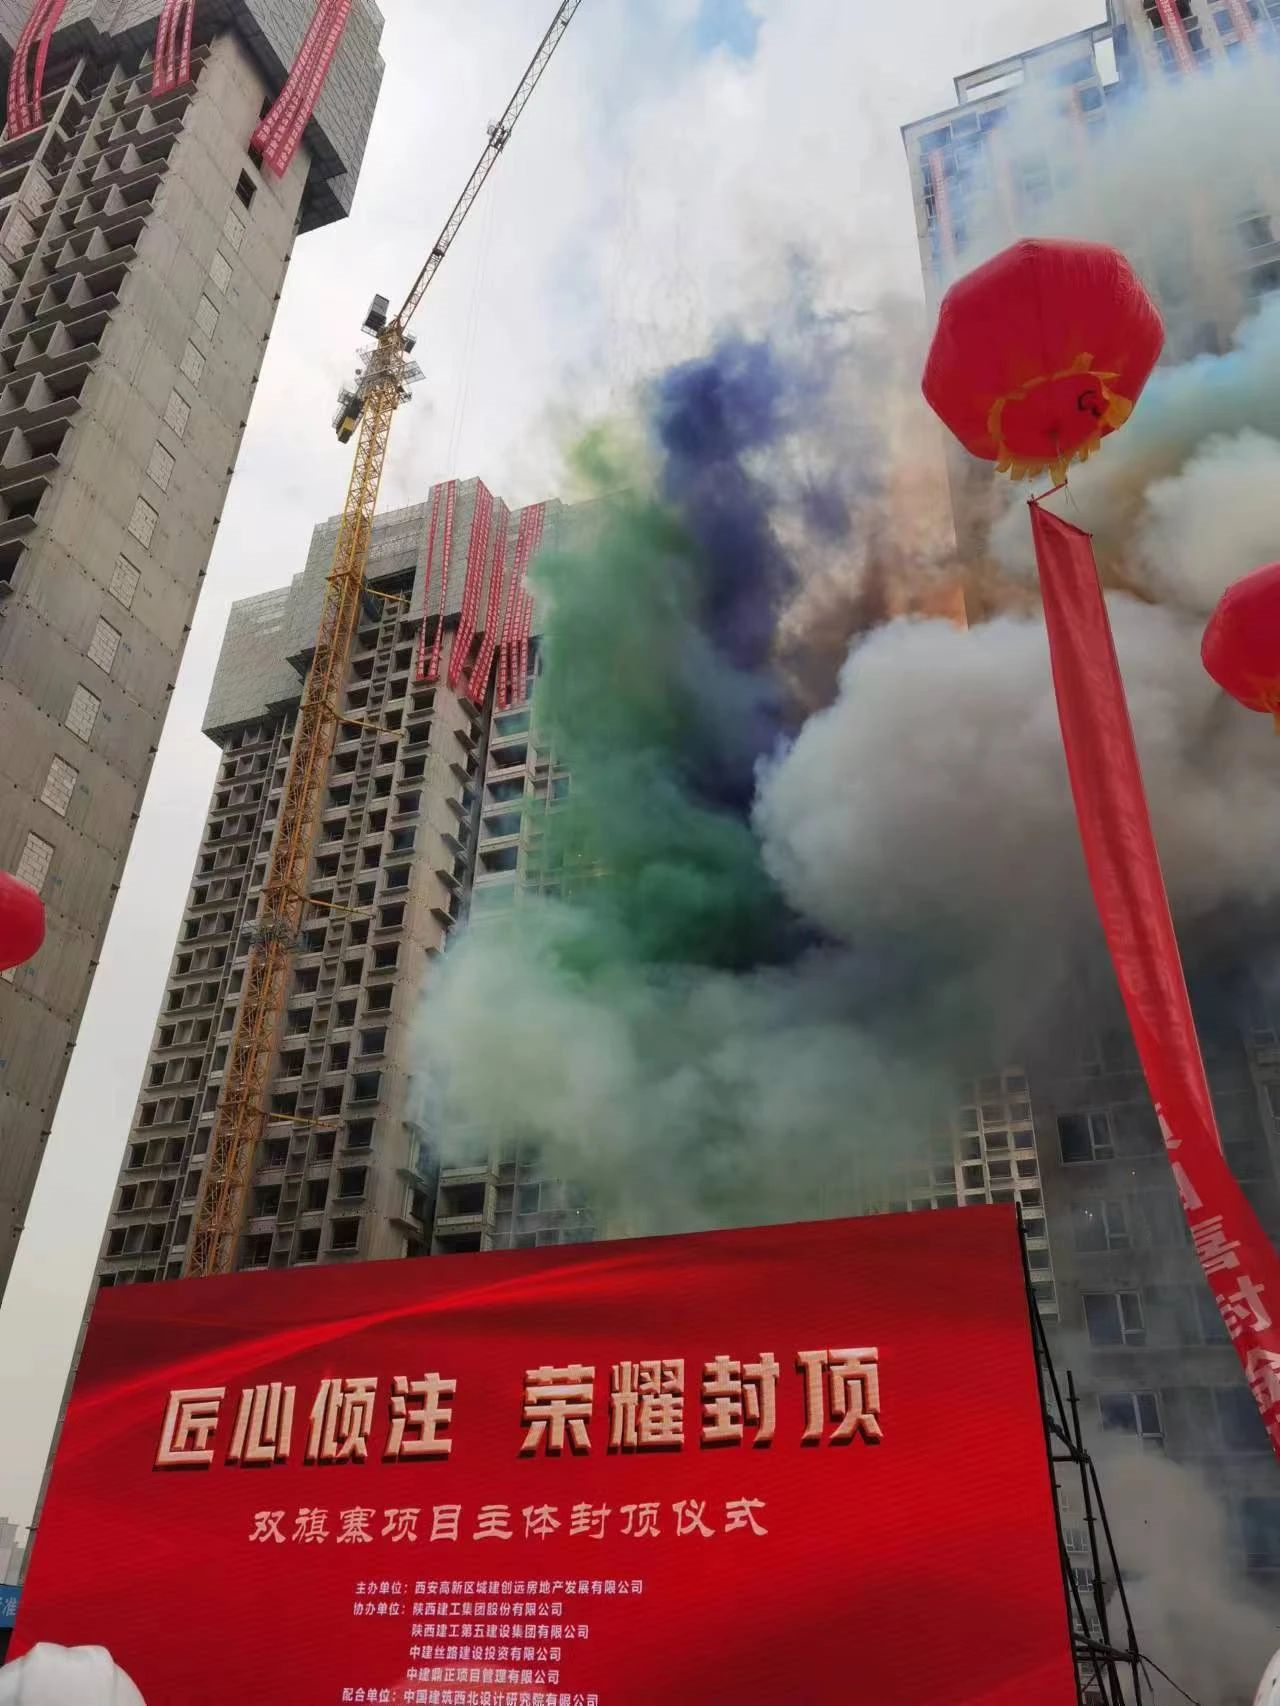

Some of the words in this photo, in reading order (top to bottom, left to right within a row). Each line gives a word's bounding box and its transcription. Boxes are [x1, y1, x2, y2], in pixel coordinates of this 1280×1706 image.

[155, 1373, 457, 1468] 匠心倾注
[520, 1346, 884, 1454] 荣耀封顶
[248, 1498, 769, 1544] 双旗寨项目主体封顶仪式
[411, 1623, 589, 1640] 陕西建工第五建设集团有限公司
[409, 1645, 561, 1662] 中建丝路建设投资有限公司
